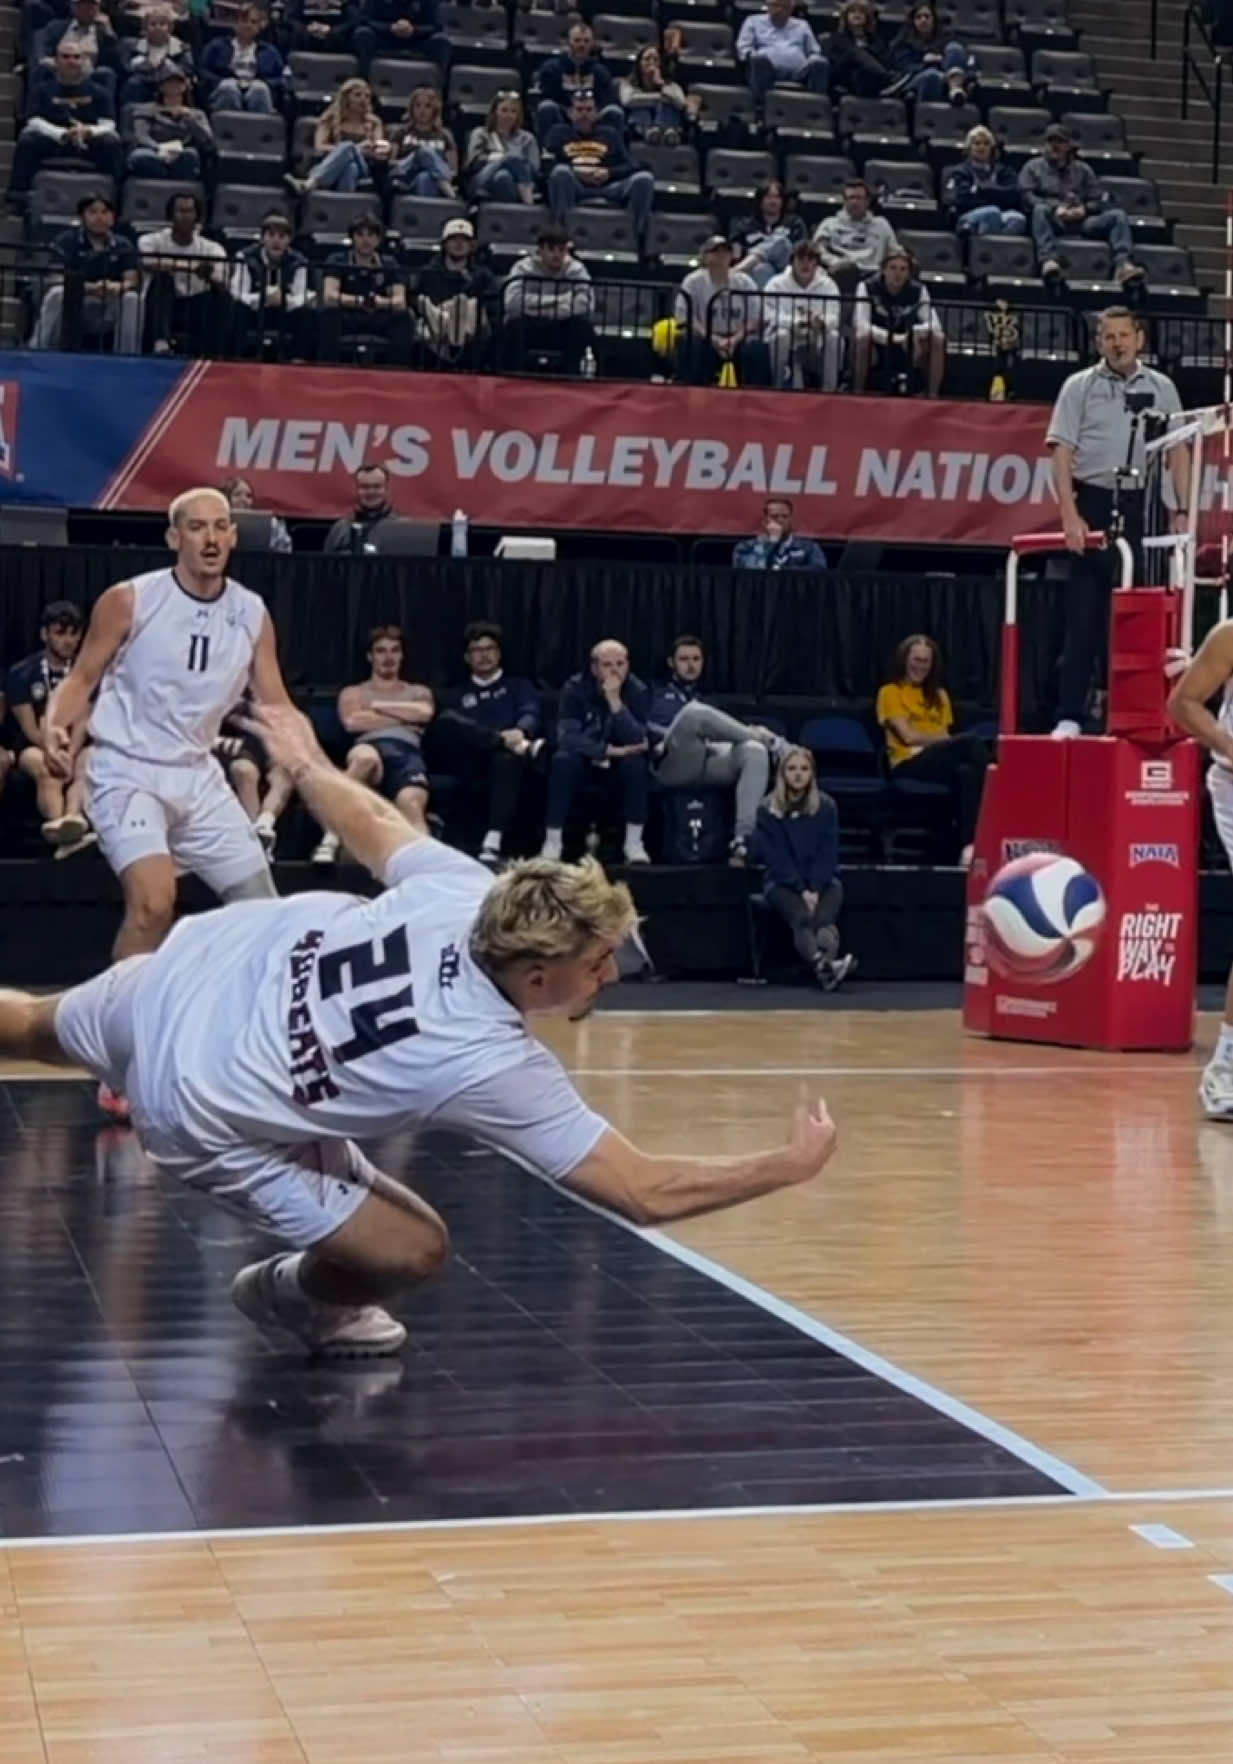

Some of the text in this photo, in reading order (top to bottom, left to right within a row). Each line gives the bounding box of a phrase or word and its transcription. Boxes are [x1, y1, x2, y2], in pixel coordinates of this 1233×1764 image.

[216, 416, 431, 476] MEN'S
[451, 427, 837, 496] VOLLEYBALL
[187, 634, 210, 672] 11
[1130, 844, 1179, 866] NAIA
[1120, 912, 1184, 939] RIGHT
[1119, 938, 1163, 963] WAY
[1117, 953, 1176, 986] PLAY
[318, 922, 420, 1065] 24
